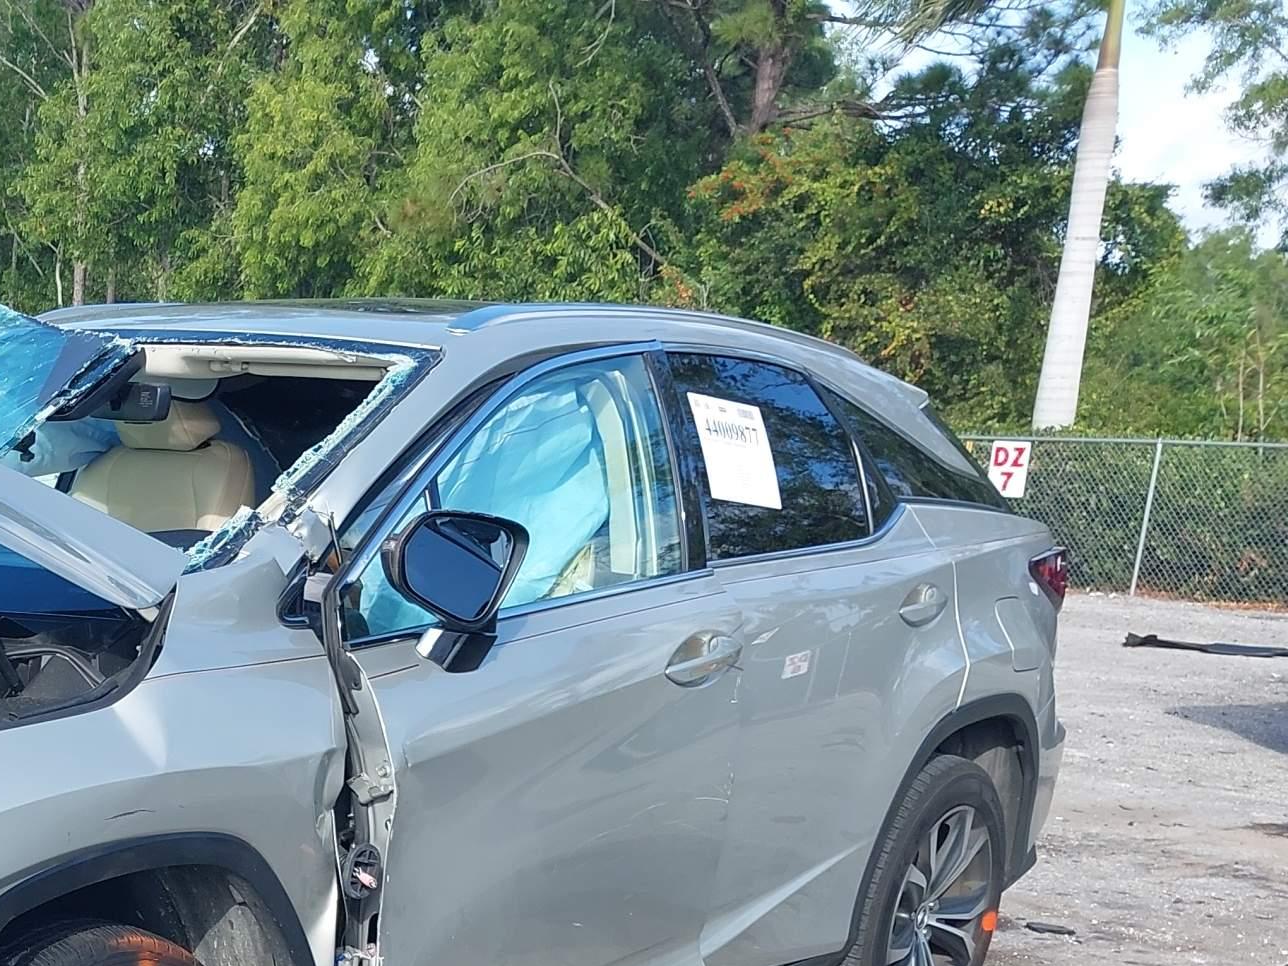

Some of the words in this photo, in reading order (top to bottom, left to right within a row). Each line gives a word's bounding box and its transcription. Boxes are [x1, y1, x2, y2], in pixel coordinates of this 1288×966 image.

[705, 418, 759, 446] 44009877
[993, 446, 1027, 467] DZ
[1000, 471, 1014, 492] 7
